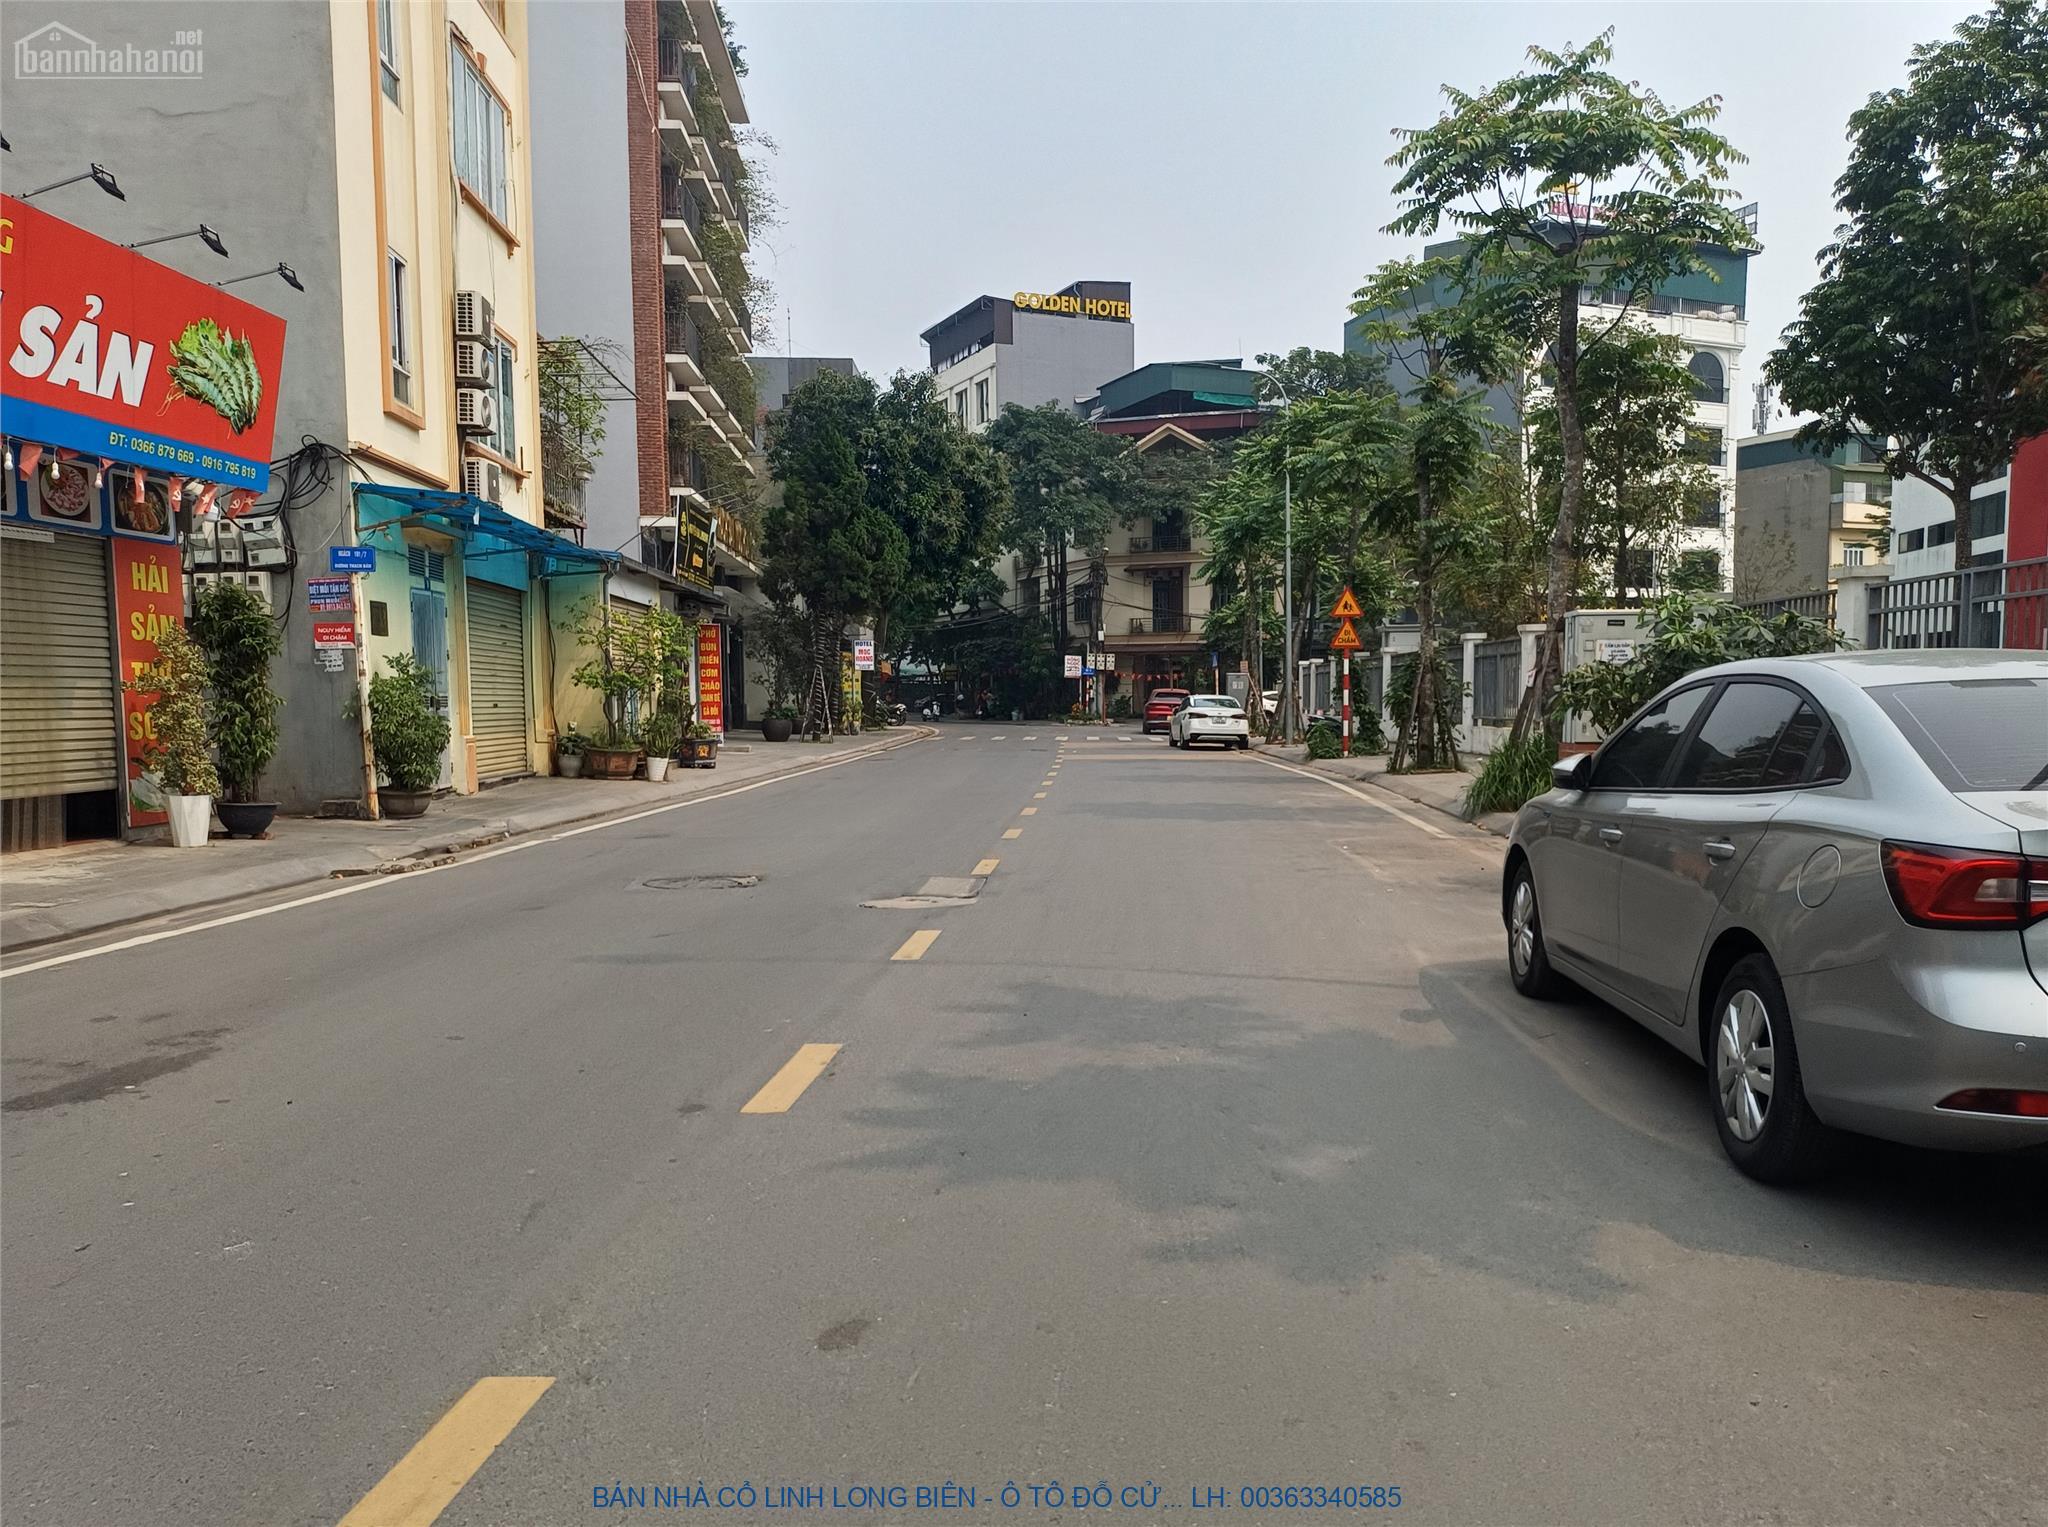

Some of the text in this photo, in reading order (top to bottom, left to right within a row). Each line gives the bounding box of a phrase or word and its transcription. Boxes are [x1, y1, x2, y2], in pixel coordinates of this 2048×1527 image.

[1013, 291, 1132, 318] GOLDEN HOTEL
[9, 294, 154, 408] SẢN
[109, 431, 128, 448] ĐT:
[130, 437, 155, 454] 0366
[157, 444, 175, 459] 879
[177, 449, 195, 464] 669
[202, 455, 222, 471] 0916
[225, 461, 240, 475] 795
[241, 466, 256, 479] 819
[131, 555, 169, 594] HẢI
[700, 627, 716, 638] PHỞ
[700, 680, 720, 690] CHÁO
[701, 668, 718, 677] CƠM
